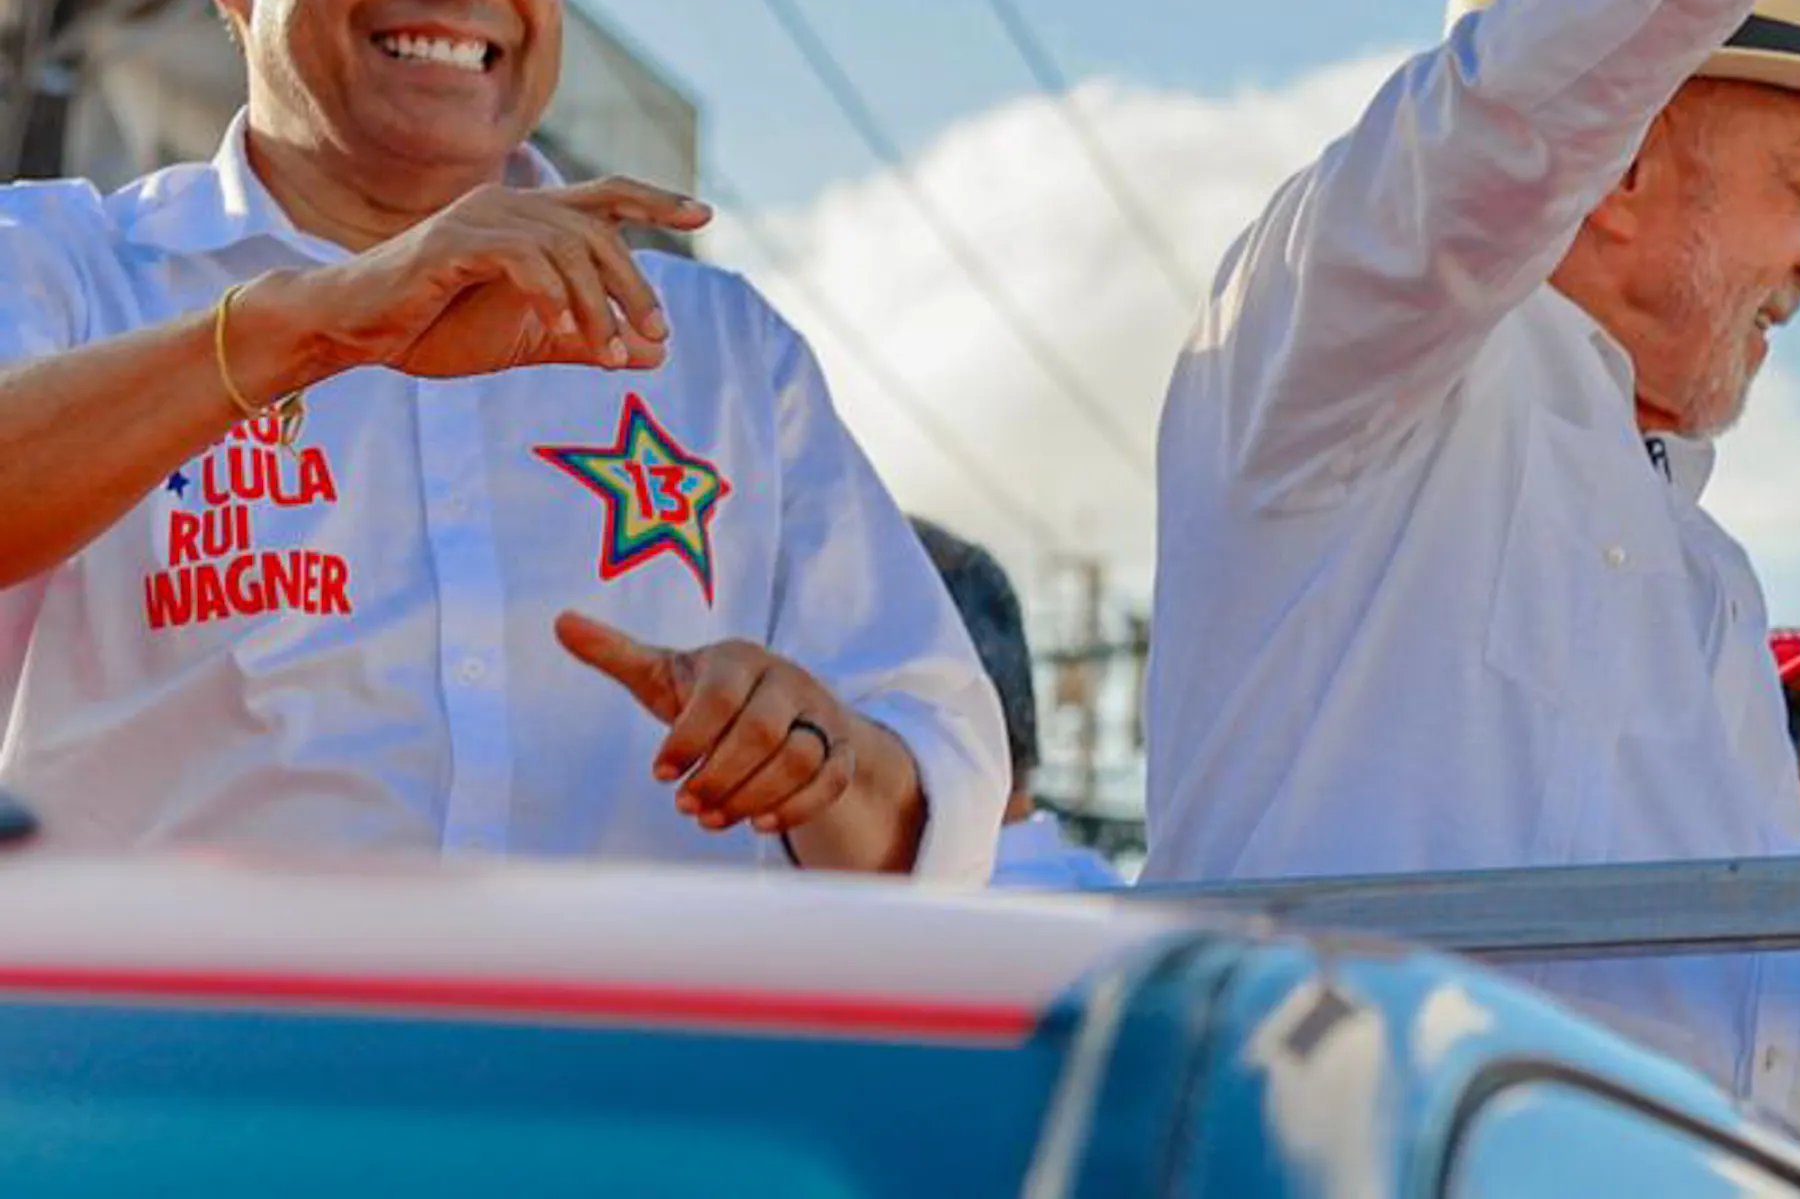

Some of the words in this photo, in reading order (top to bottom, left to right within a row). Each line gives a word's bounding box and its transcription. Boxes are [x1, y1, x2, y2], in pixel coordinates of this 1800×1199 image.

[202, 447, 337, 506] LULA
[623, 459, 694, 528] 13
[168, 503, 249, 566] RUI
[145, 550, 352, 630] WAGNER
